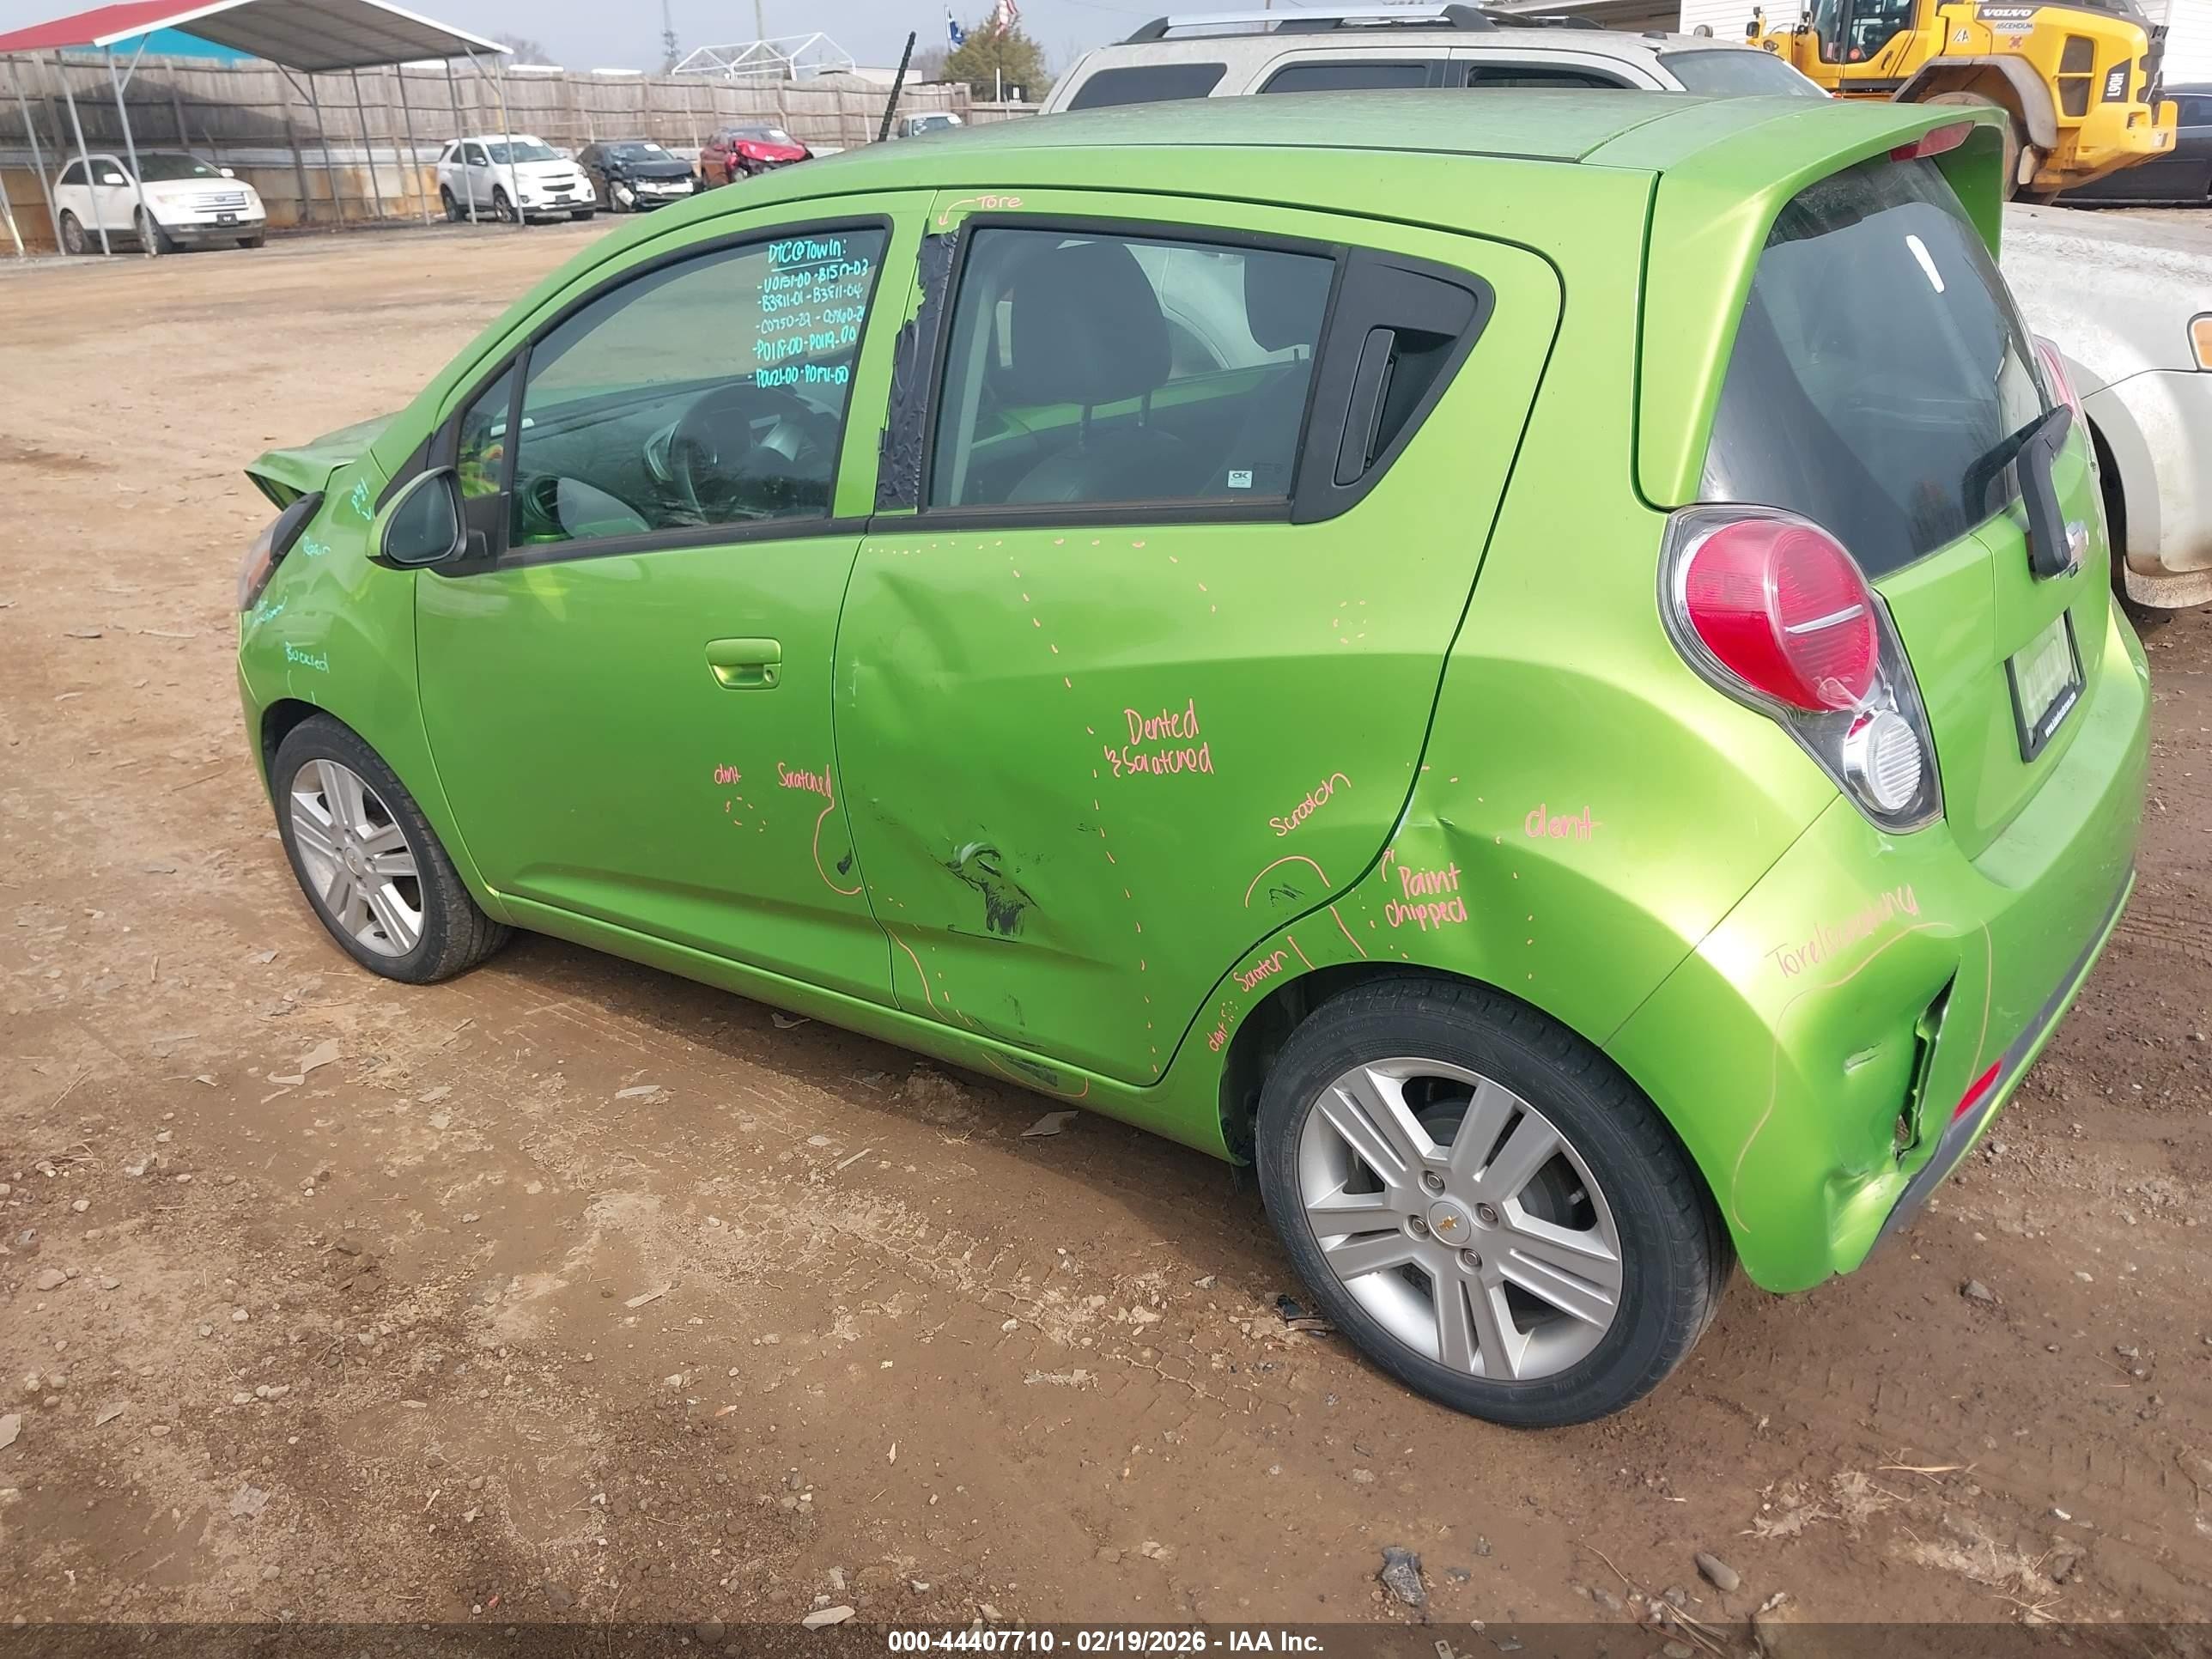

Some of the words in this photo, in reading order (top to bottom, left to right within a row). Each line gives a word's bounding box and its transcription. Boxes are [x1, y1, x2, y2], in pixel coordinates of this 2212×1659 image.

[2106, 73, 2124, 96] L90H
[976, 194, 1024, 209] Tore
[1123, 697, 1200, 745] Dented
[1525, 803, 1603, 840] dent
[1397, 861, 1462, 901] Paint
[1384, 896, 1468, 932] chipped
[1206, 1021, 1228, 1052] dent
